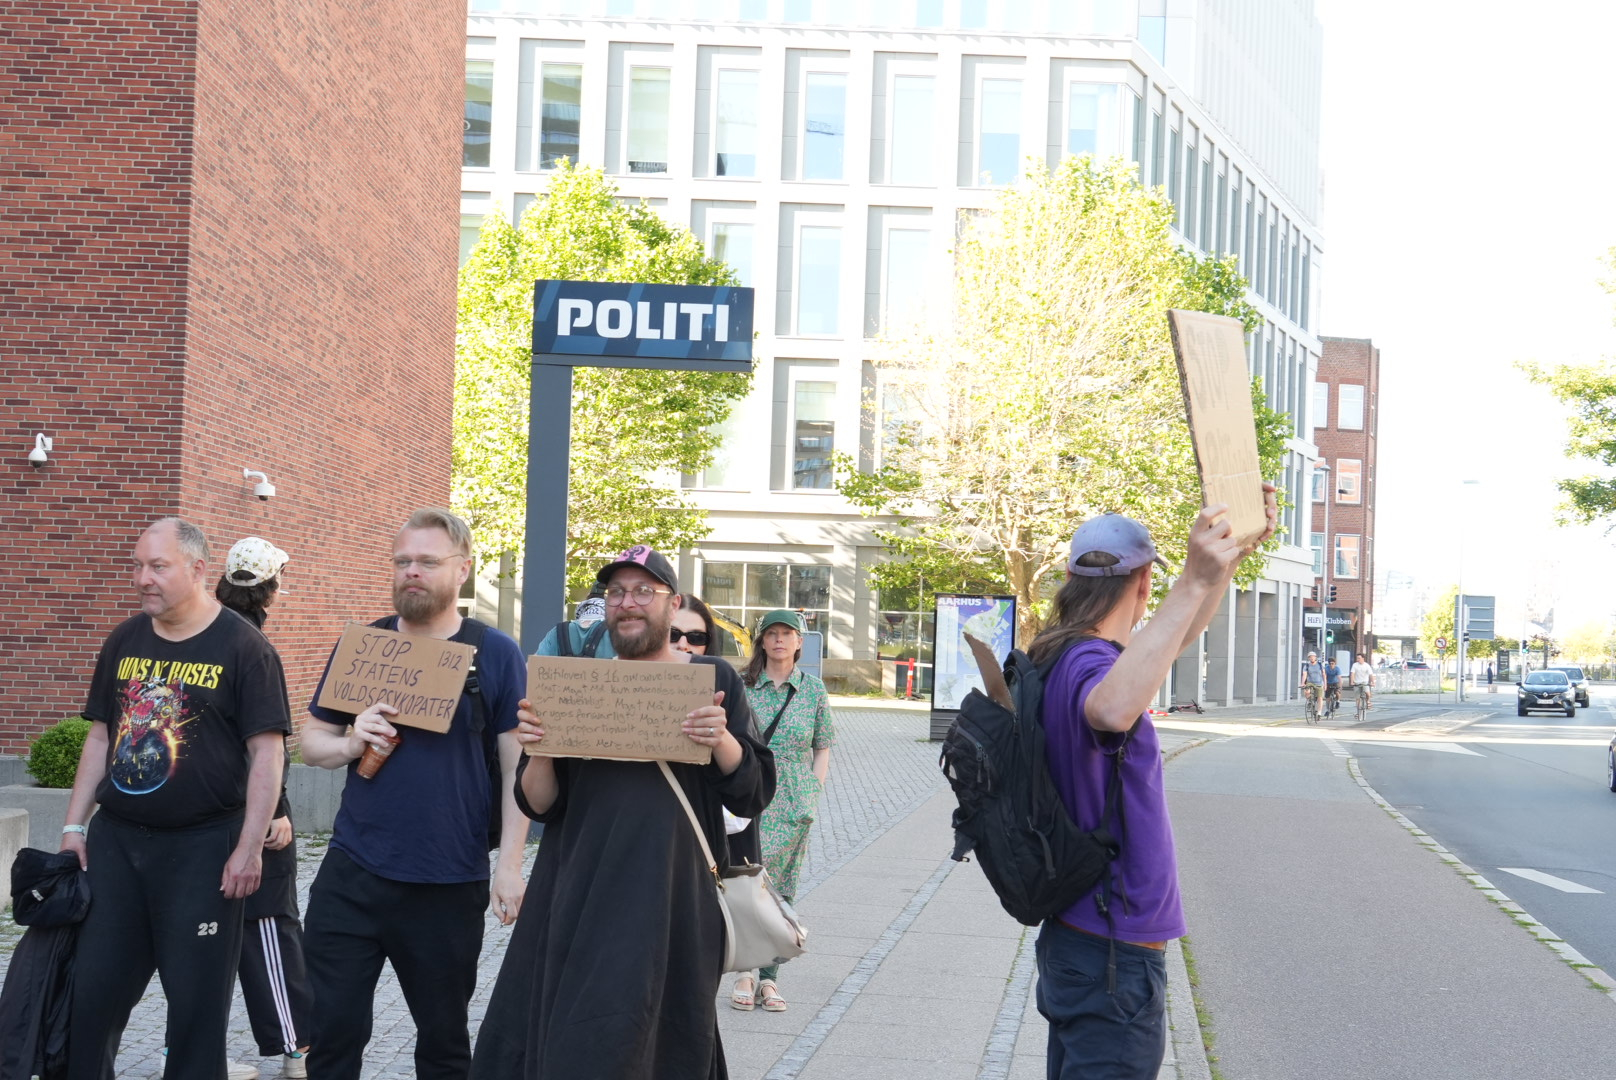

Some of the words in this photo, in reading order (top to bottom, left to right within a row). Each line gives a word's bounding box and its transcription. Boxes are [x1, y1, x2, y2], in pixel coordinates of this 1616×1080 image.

[557, 298, 730, 342] POLITI
[938, 597, 982, 606] AARHUS
[356, 634, 412, 662] STOP
[438, 650, 462, 671] 1312
[166, 661, 224, 689] ROSES
[344, 658, 423, 687] STATENS
[334, 680, 454, 720] VOLDSPSYKOPATER
[198, 922, 218, 936] 23
